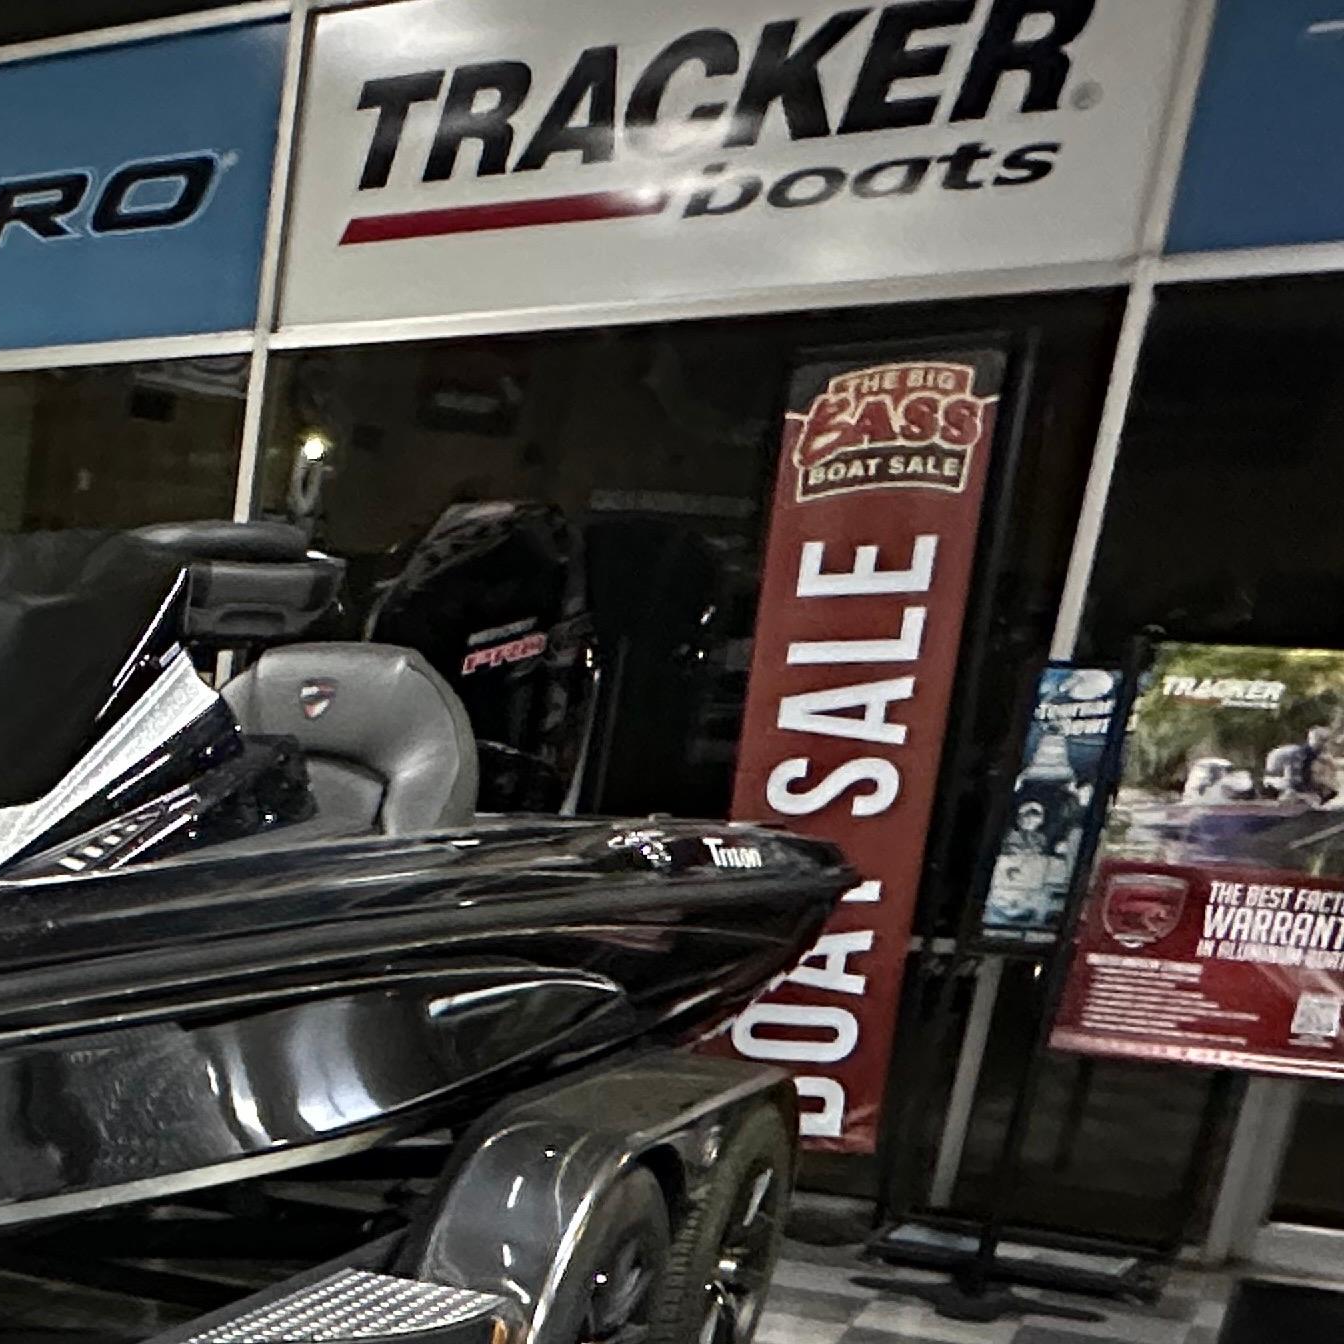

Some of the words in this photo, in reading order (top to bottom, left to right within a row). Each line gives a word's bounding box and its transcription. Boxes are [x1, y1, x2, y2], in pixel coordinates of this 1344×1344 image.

[357, 0, 1095, 191] TRACKER
[682, 139, 1061, 220] boats
[842, 371, 900, 395] THE
[906, 367, 957, 390] BIG
[808, 457, 883, 486] BOAT
[888, 455, 961, 477] SALE
[766, 534, 939, 817] SALE
[1162, 675, 1287, 701] TRACKER
[1208, 880, 1246, 906] THE
[1246, 884, 1296, 911] BEST
[1293, 888, 1344, 916] FACT
[731, 878, 882, 1138] OA
